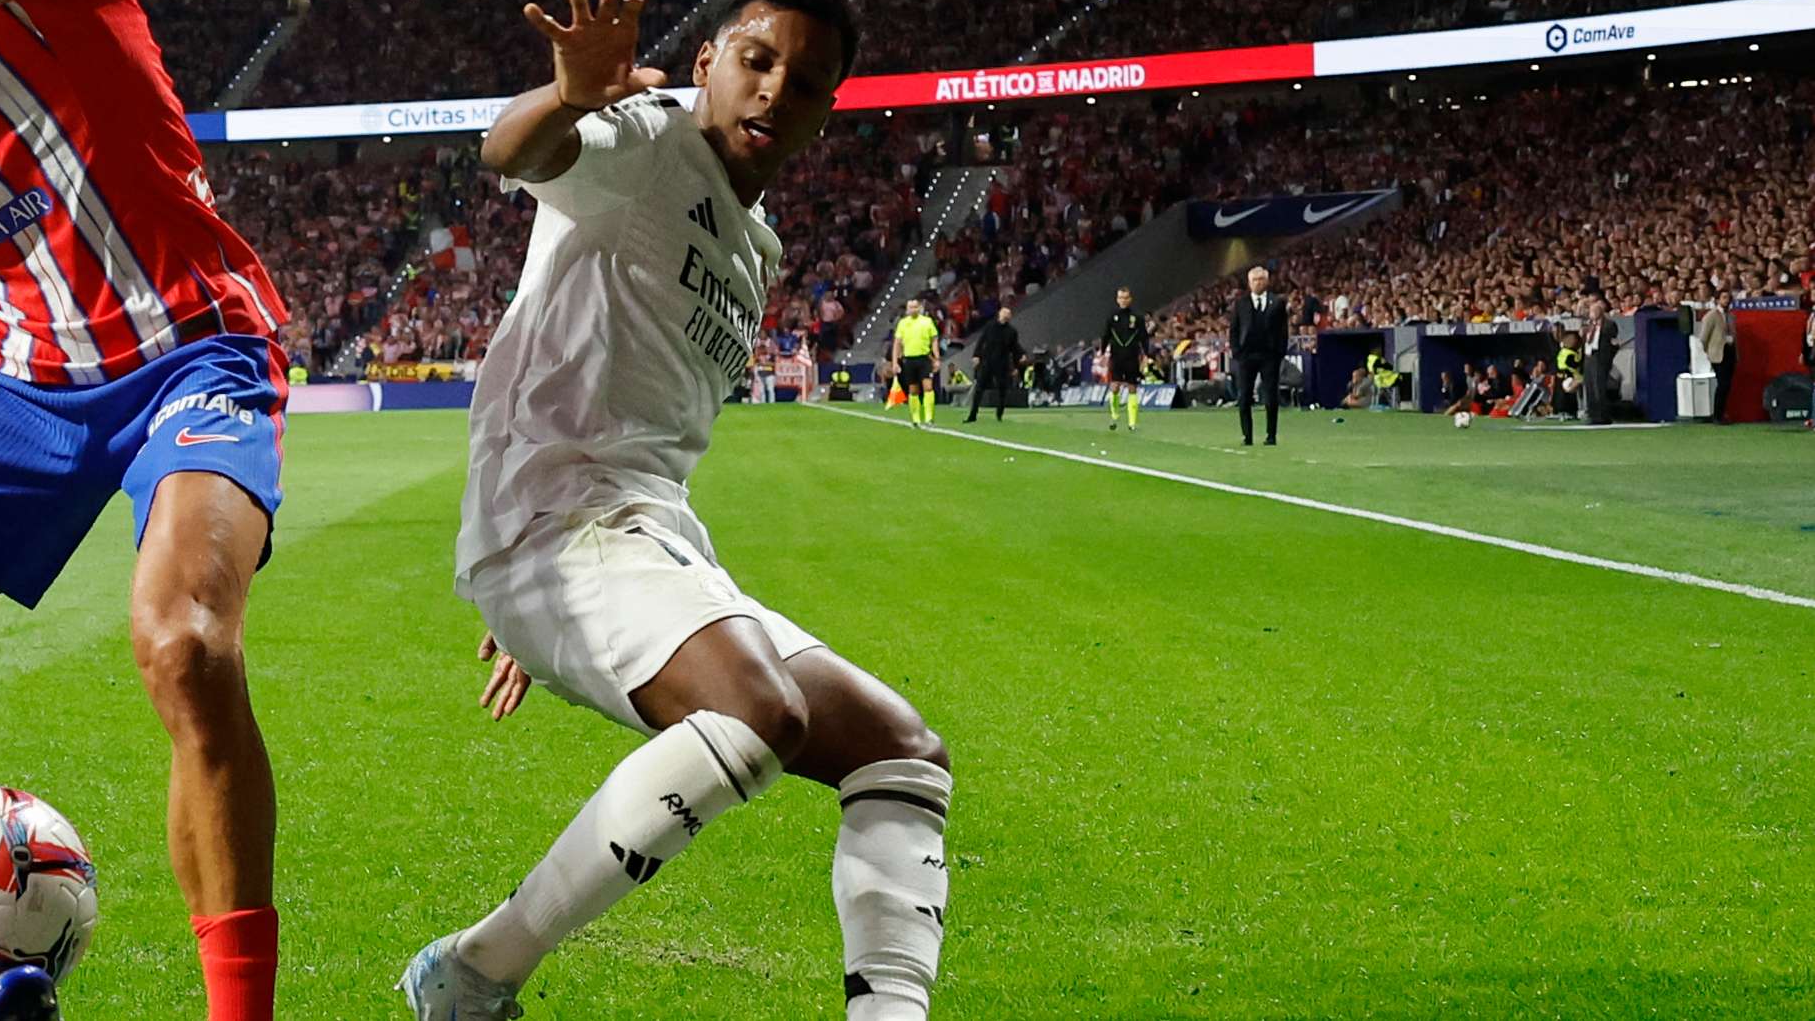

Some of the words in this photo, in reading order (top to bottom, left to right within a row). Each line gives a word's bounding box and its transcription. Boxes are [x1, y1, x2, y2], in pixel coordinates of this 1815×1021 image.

[1573, 25, 1635, 44] ComAve
[936, 70, 1034, 100] ATLÉTICO
[1058, 64, 1146, 92] MADRID
[8, 190, 50, 228] AIR
[685, 306, 713, 346] FLY
[154, 392, 254, 426] ComAve
